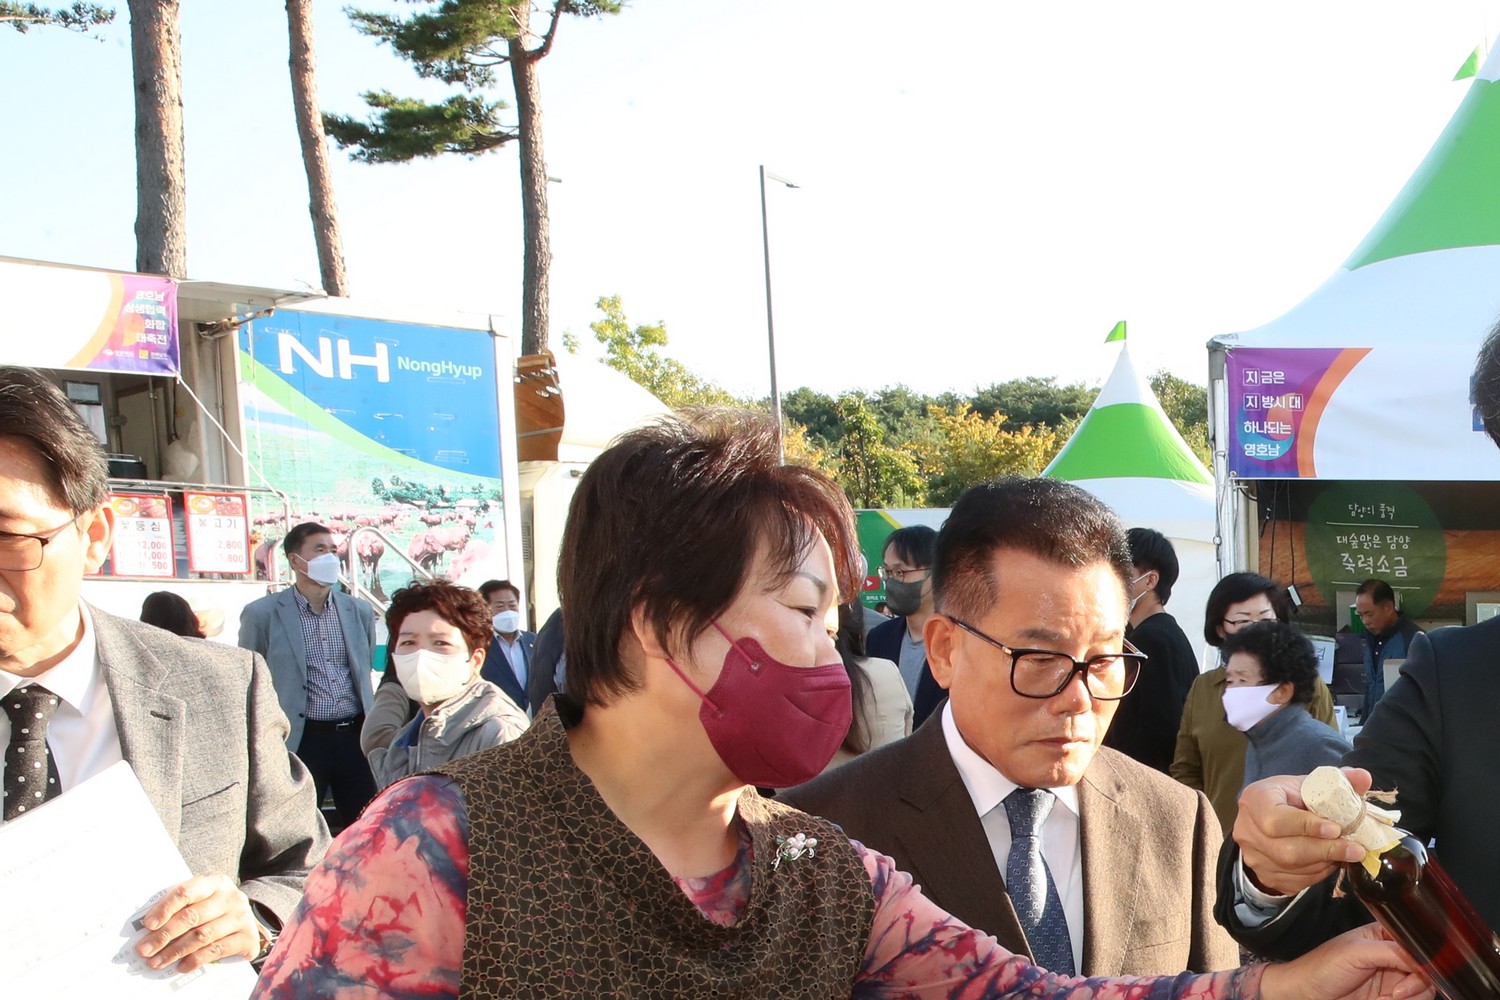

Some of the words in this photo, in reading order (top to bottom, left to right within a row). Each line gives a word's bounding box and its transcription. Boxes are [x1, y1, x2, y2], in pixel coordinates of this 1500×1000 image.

[278, 333, 390, 383] NH
[397, 356, 483, 380] NongHyup
[1243, 420, 1292, 435] 하나되는
[1244, 443, 1281, 457] 영호남
[1348, 503, 1375, 518] 담양의
[1336, 533, 1382, 549] 대숲맑은
[1386, 535, 1411, 549] 담양
[1340, 553, 1408, 577] 죽력소금
